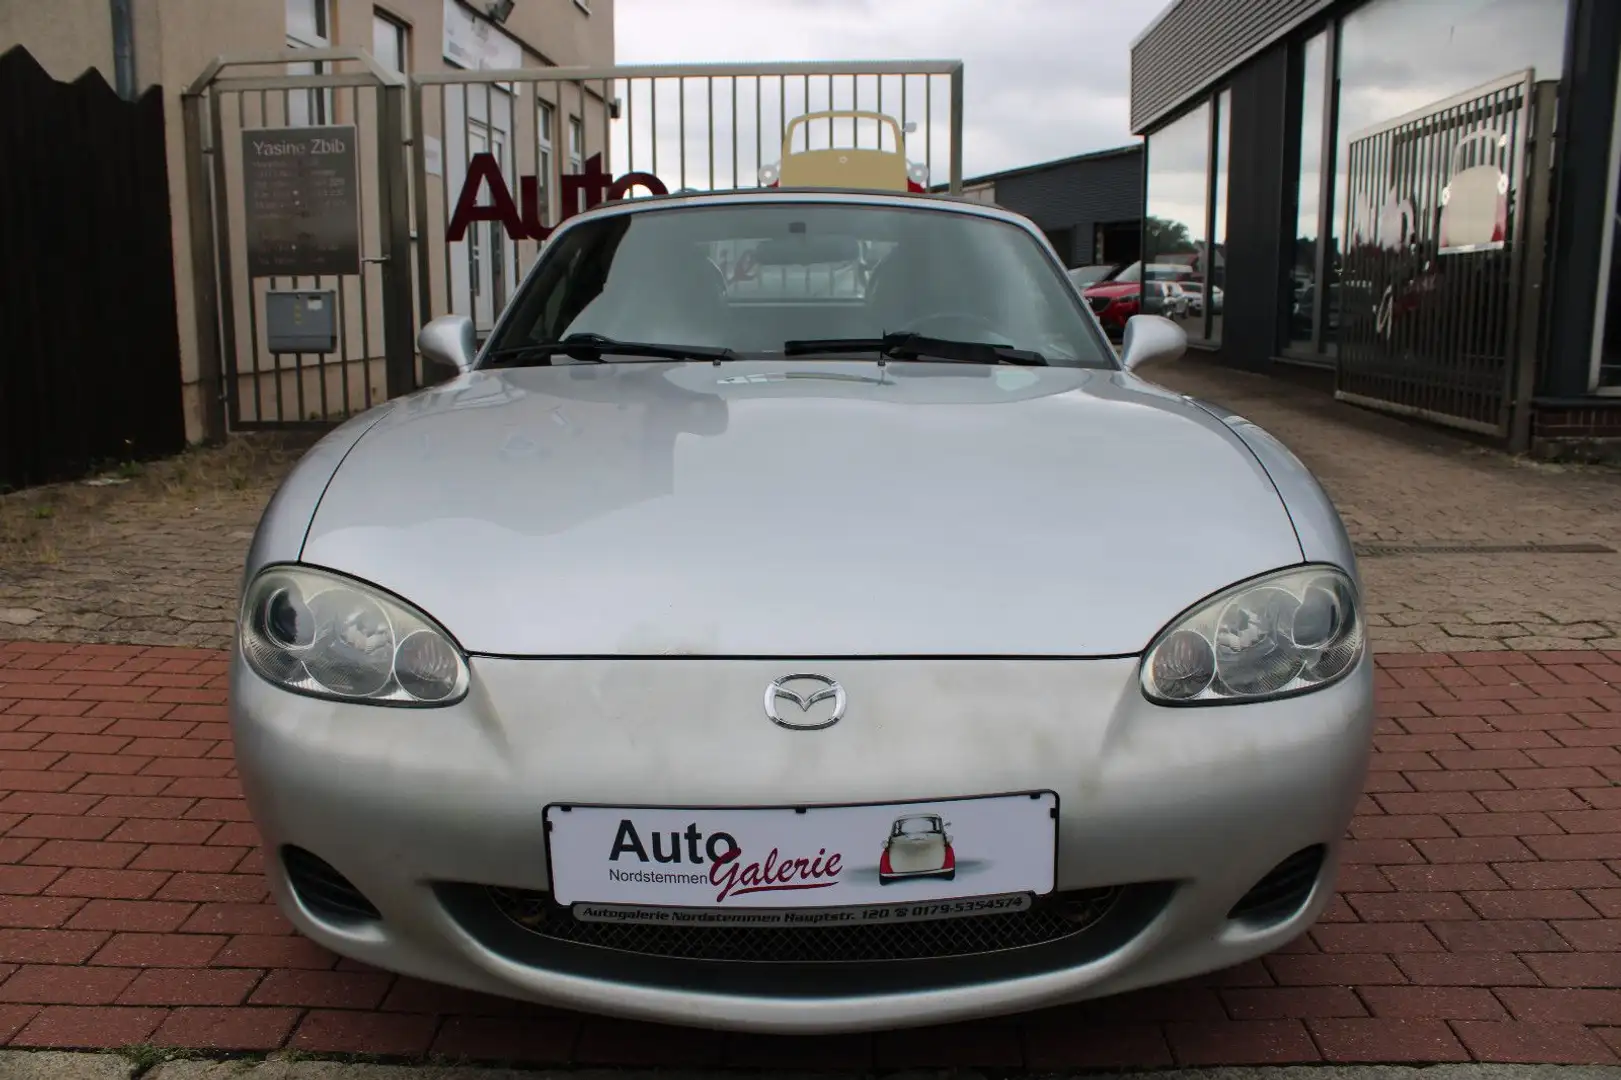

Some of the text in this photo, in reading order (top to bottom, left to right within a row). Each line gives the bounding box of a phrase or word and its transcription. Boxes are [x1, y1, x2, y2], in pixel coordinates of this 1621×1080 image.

[253, 138, 346, 157] Yasine Zbib
[609, 819, 738, 864] Auto
[609, 868, 708, 885] Nordstemmen
[709, 848, 843, 902] Galerie
[582, 896, 1024, 924] Autogalerie Nordstemmen Hauptstr. 120 0179-5354574
